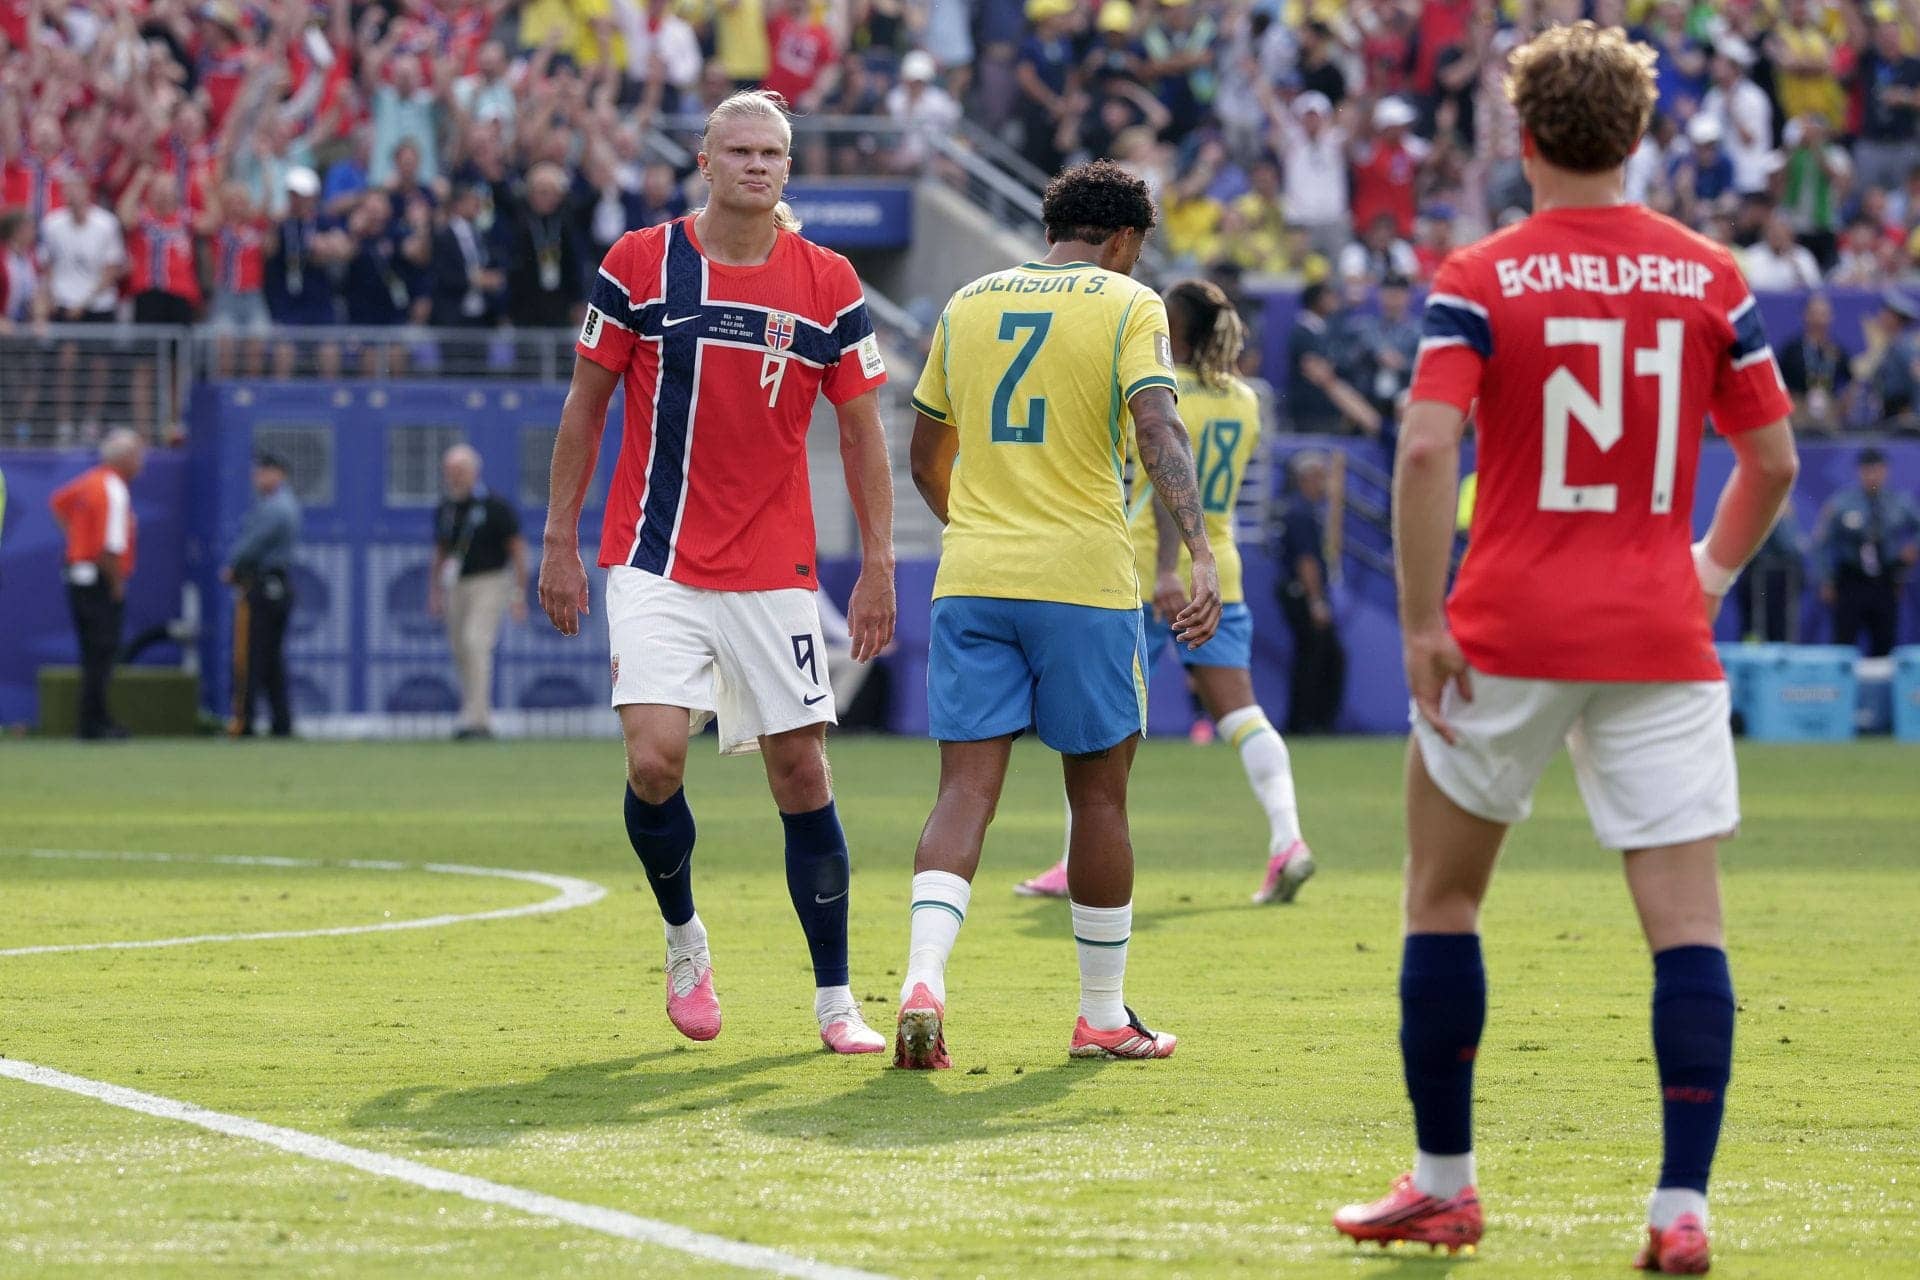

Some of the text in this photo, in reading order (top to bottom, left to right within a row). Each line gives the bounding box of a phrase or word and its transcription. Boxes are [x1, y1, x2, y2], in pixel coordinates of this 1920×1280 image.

[1083, 275, 1108, 295] S.
[1495, 253, 1714, 301] SCHJELDERUP
[760, 352, 787, 408] 9
[990, 311, 1054, 444] 2
[1537, 317, 1684, 515] 21
[1196, 421, 1242, 512] 18
[791, 634, 819, 686] 9
